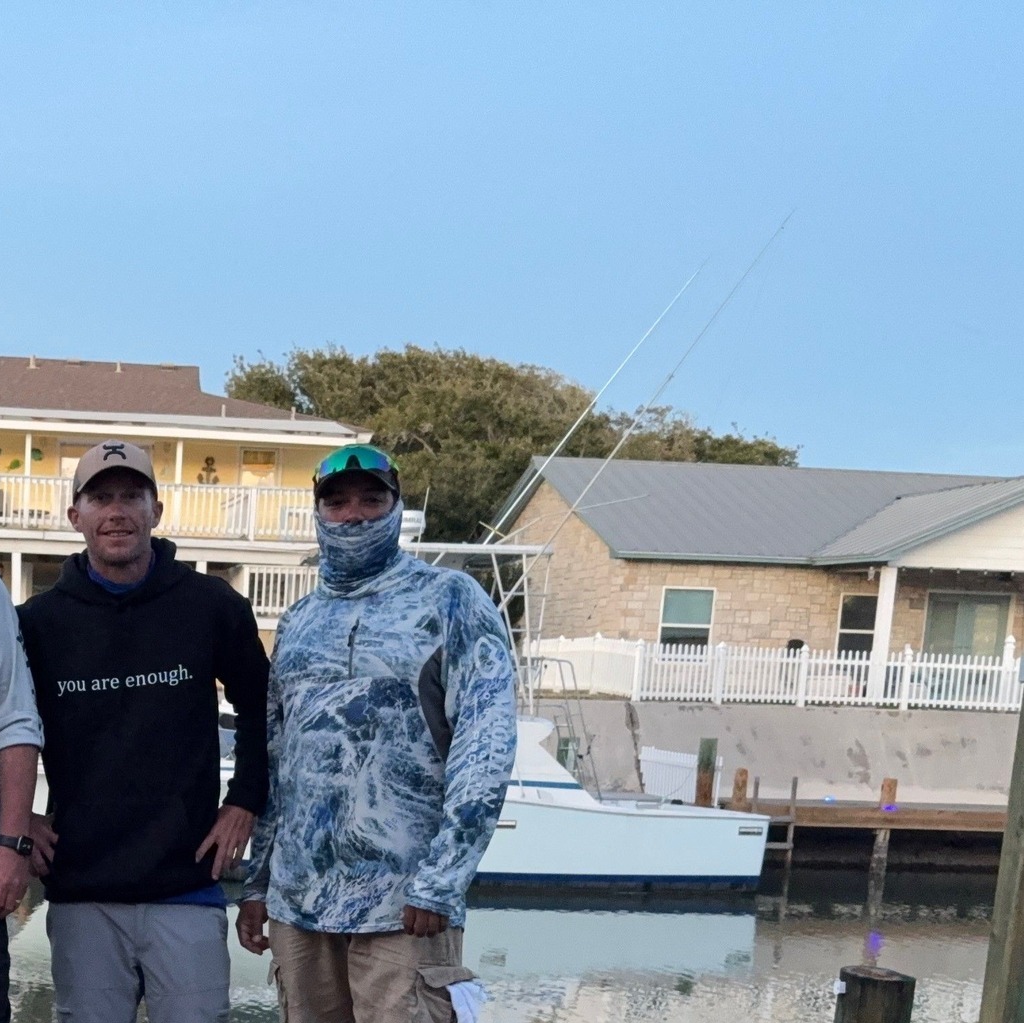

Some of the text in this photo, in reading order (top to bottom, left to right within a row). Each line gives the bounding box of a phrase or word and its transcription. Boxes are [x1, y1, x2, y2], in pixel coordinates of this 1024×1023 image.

[57, 664, 193, 696] you are enough.
[482, 698, 512, 807] MAGELLAN
